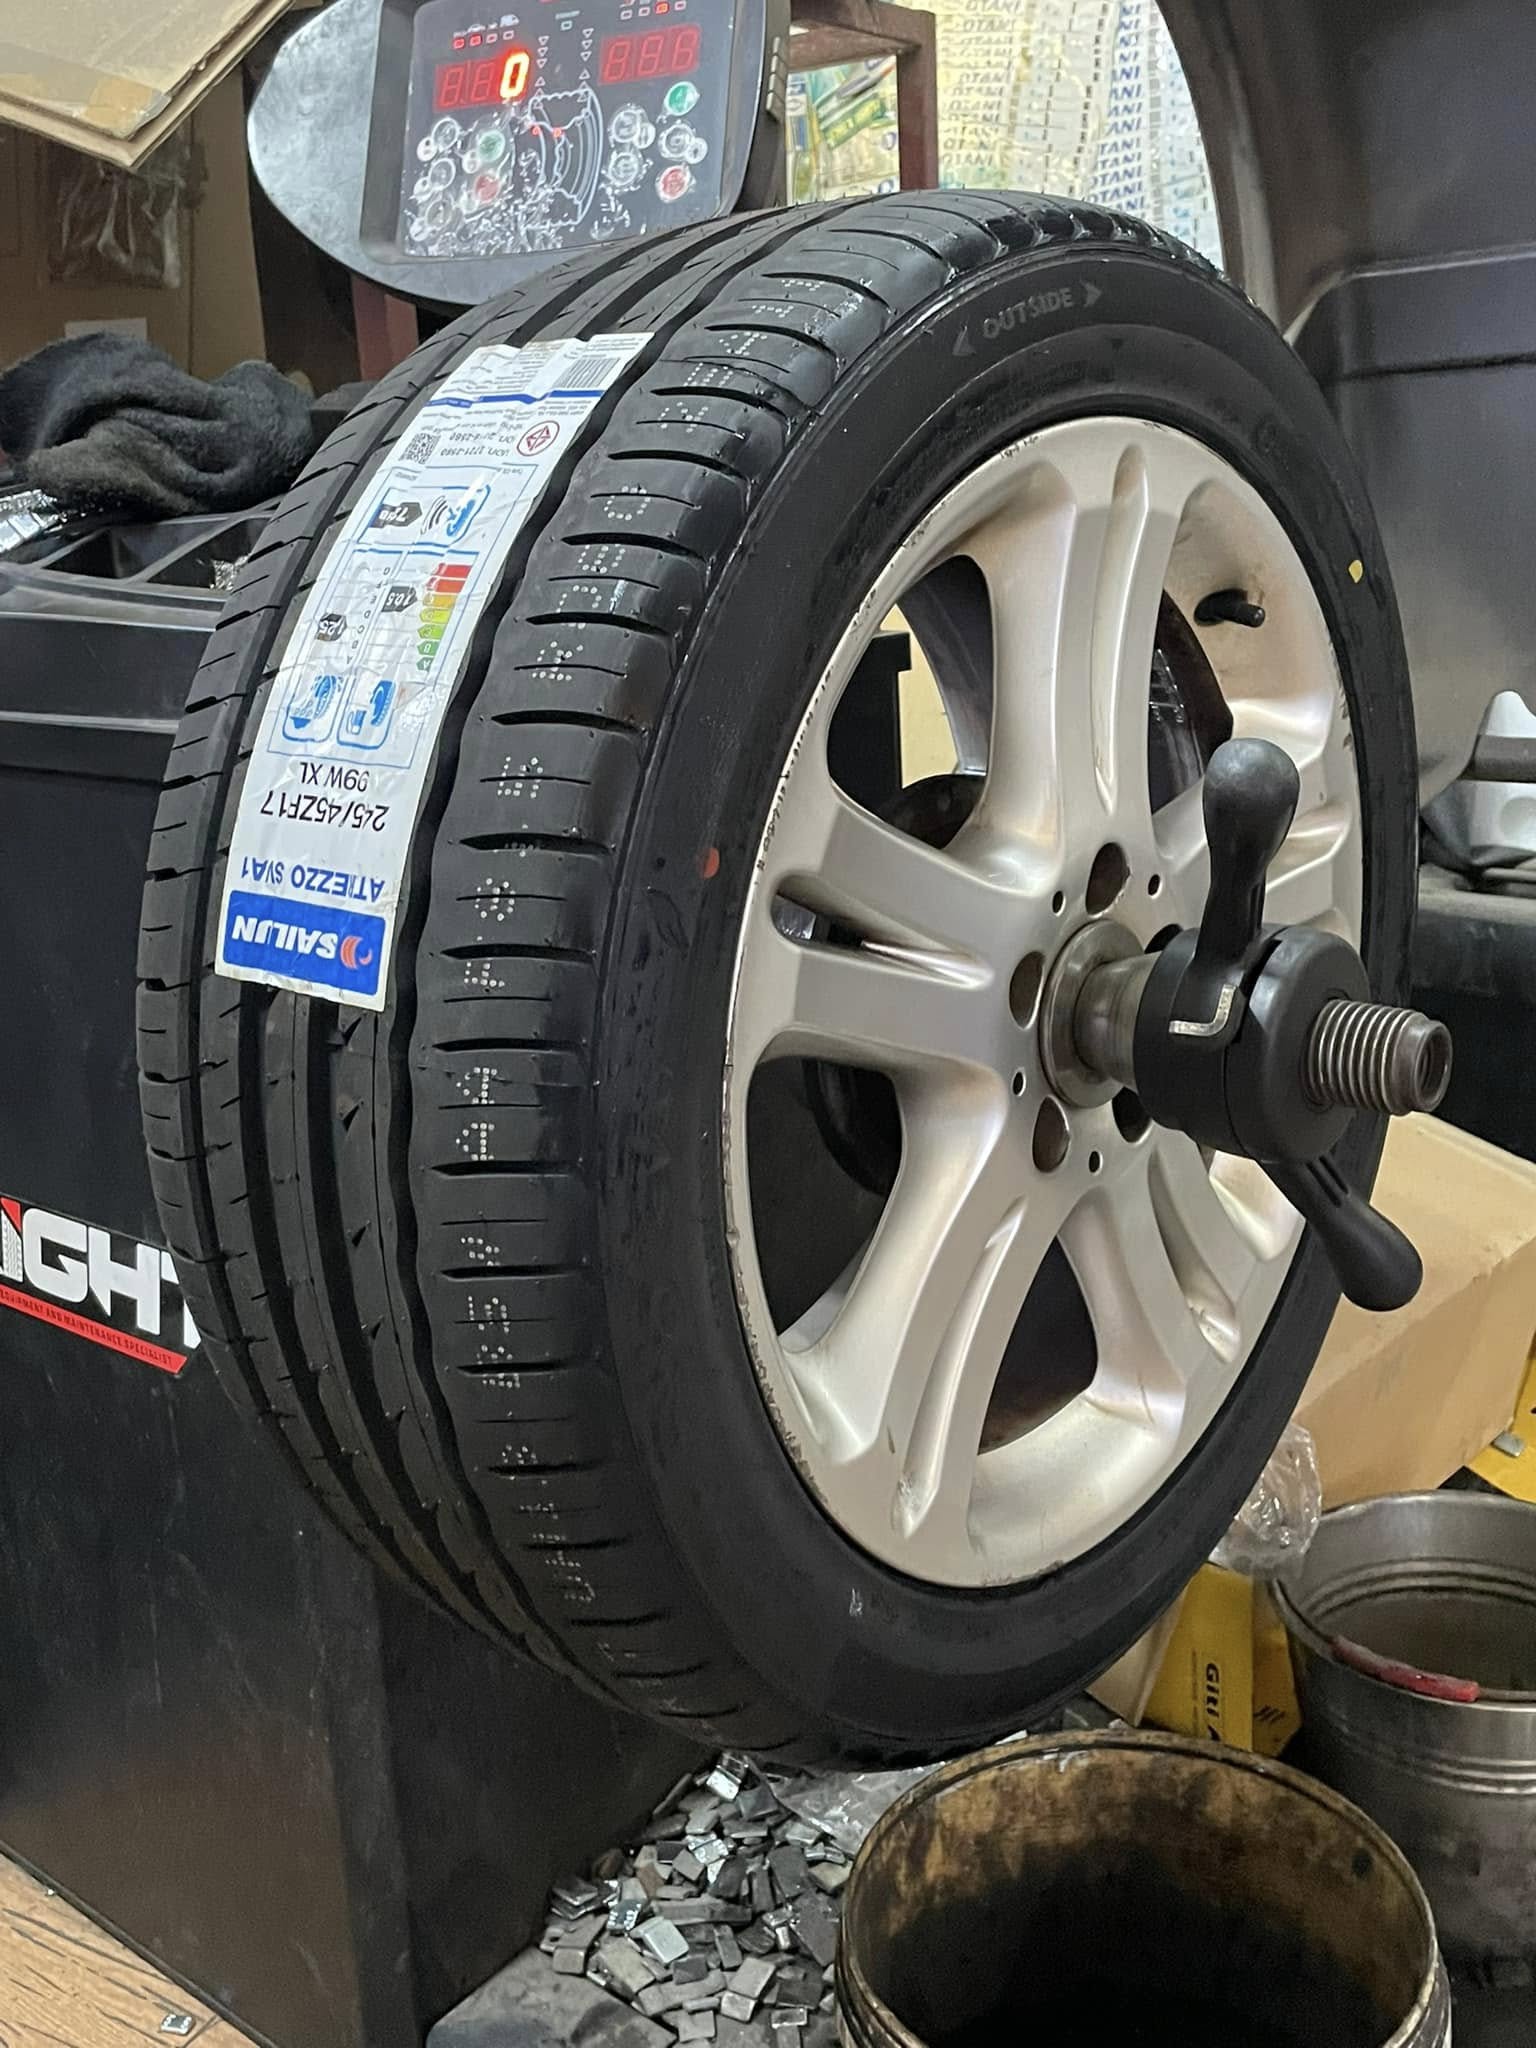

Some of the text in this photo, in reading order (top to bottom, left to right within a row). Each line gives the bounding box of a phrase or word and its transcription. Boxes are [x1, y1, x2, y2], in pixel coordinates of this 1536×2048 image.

[983, 287, 1073, 338] OUTSIDE
[300, 762, 324, 786] XL
[241, 856, 285, 885] SVA1
[231, 914, 339, 960] SAILUN
